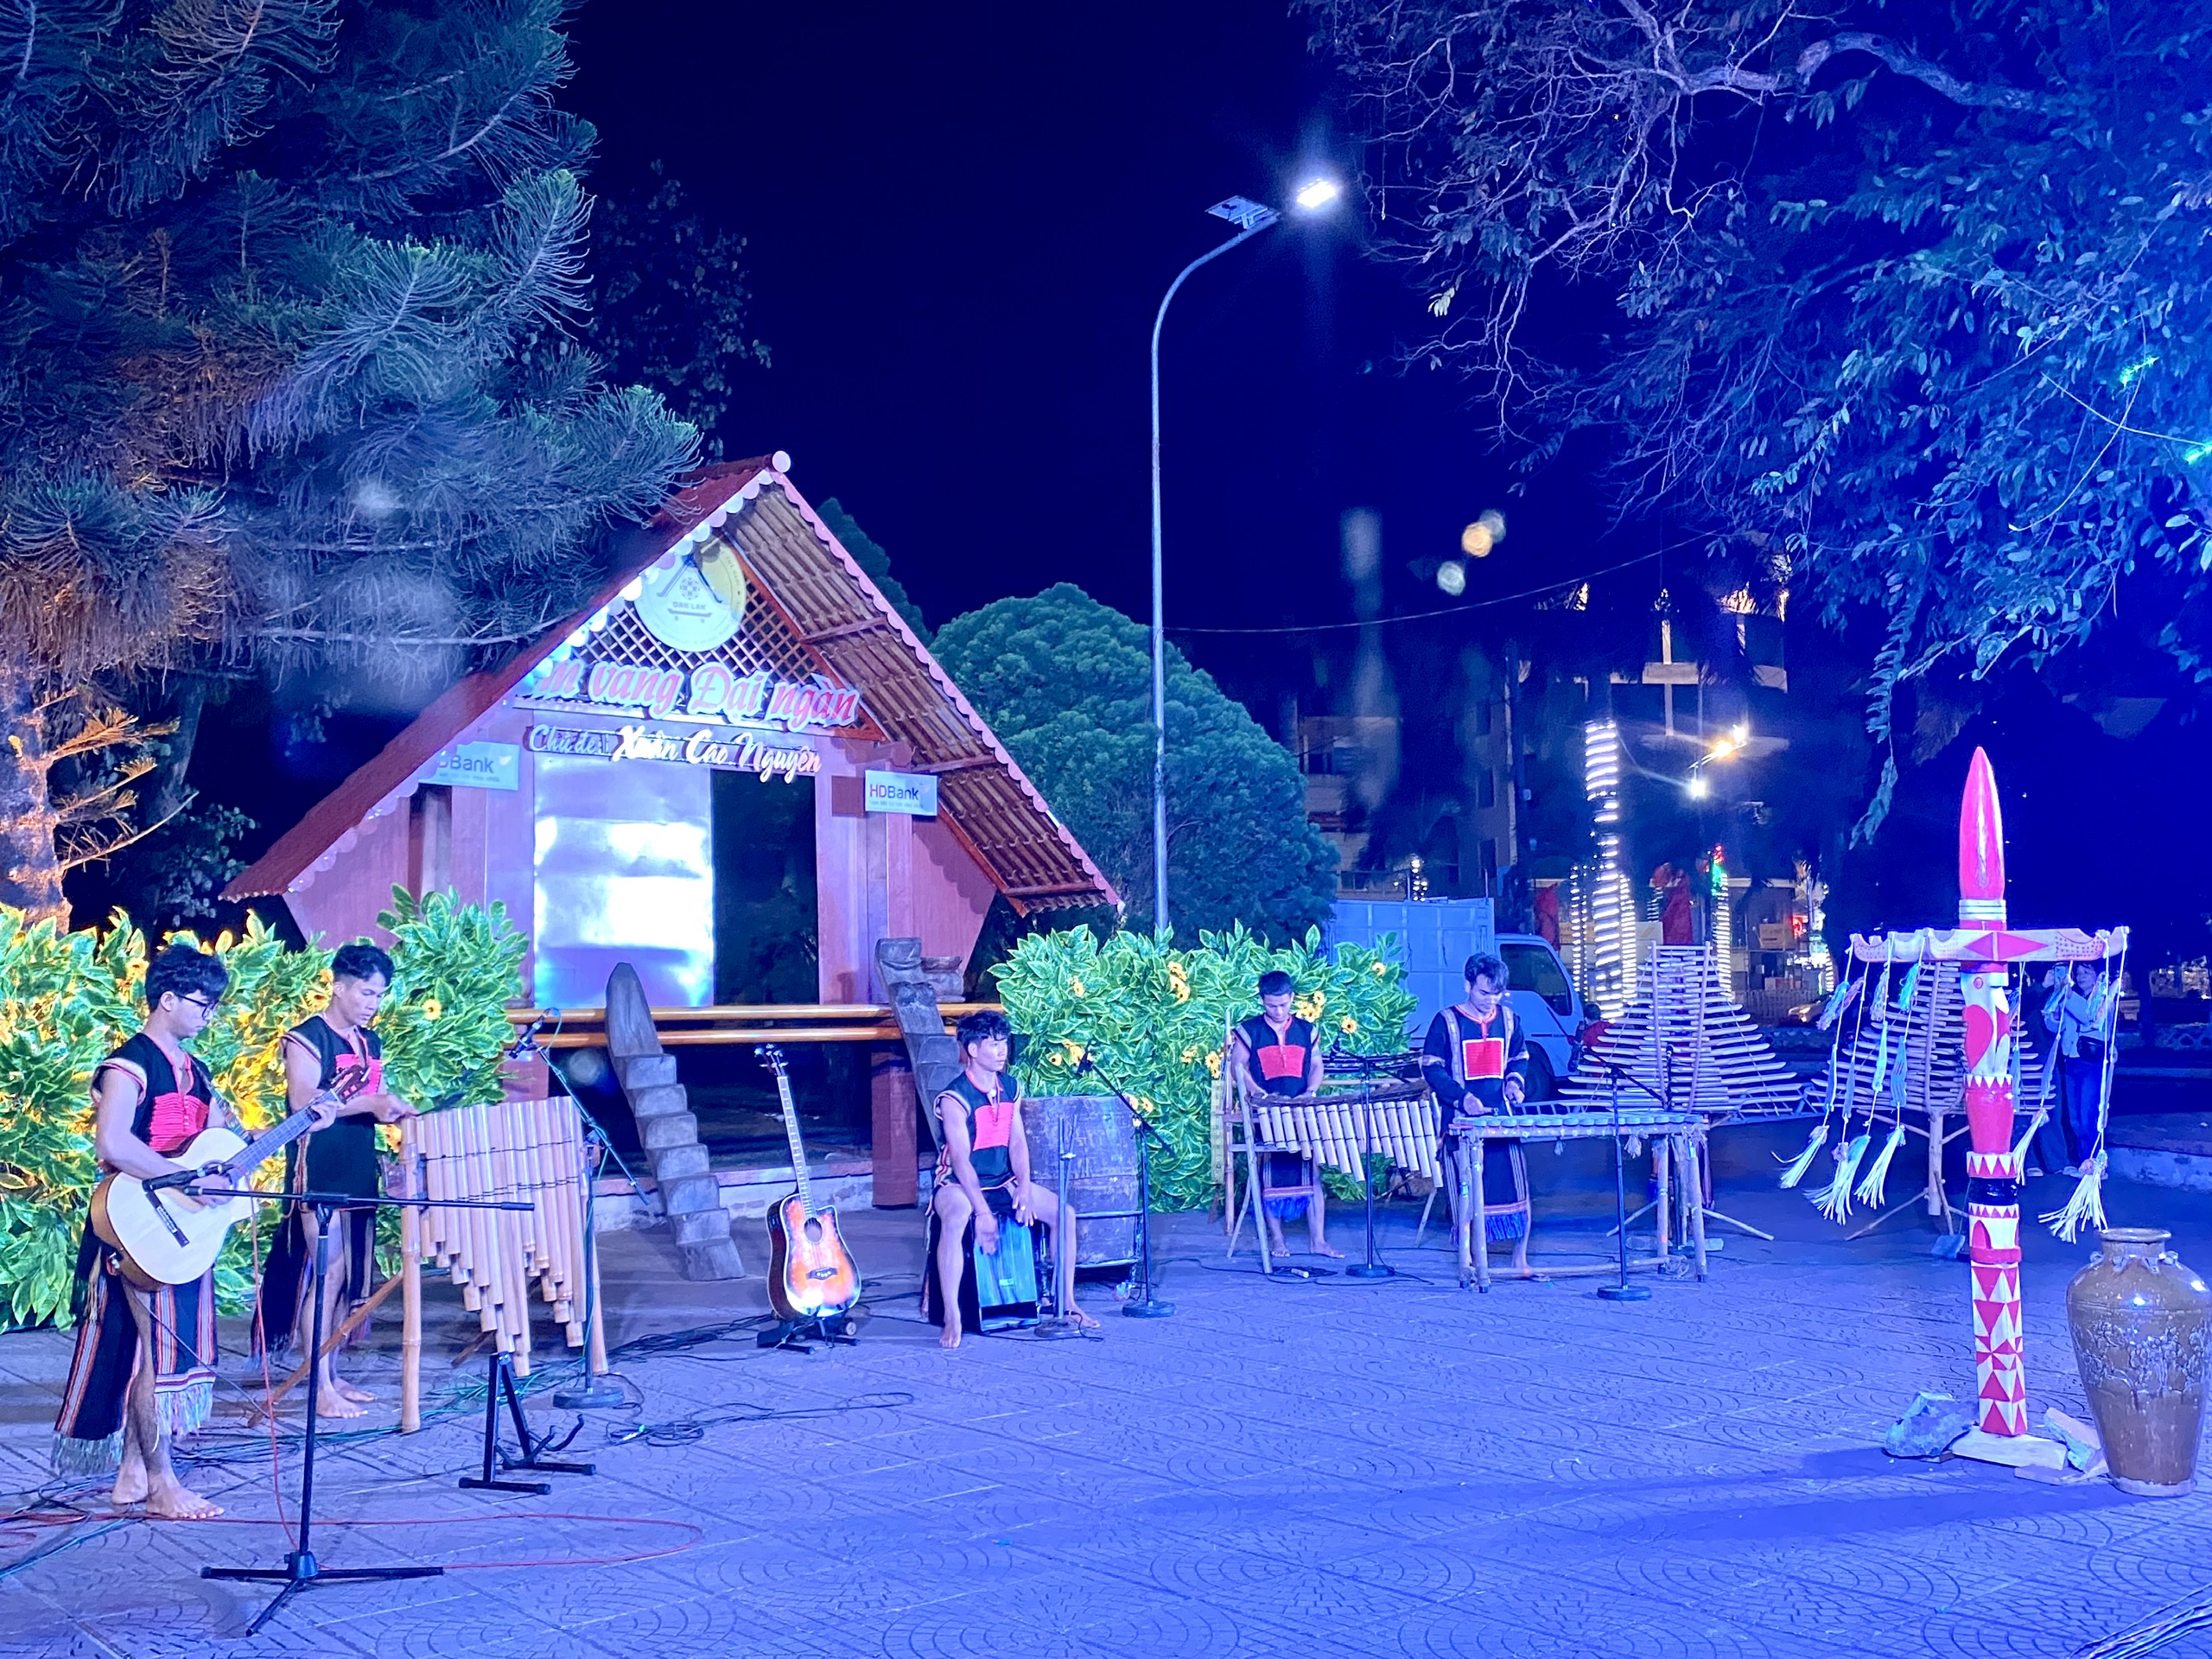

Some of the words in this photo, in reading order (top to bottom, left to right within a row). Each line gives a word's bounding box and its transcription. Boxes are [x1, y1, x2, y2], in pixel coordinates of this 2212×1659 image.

[588, 662, 683, 719] vang
[688, 662, 770, 724] Đại
[766, 673, 860, 732] ngàn
[686, 728, 728, 765] Cao
[734, 732, 822, 784] Nguyên
[869, 783, 919, 801] HDBank
